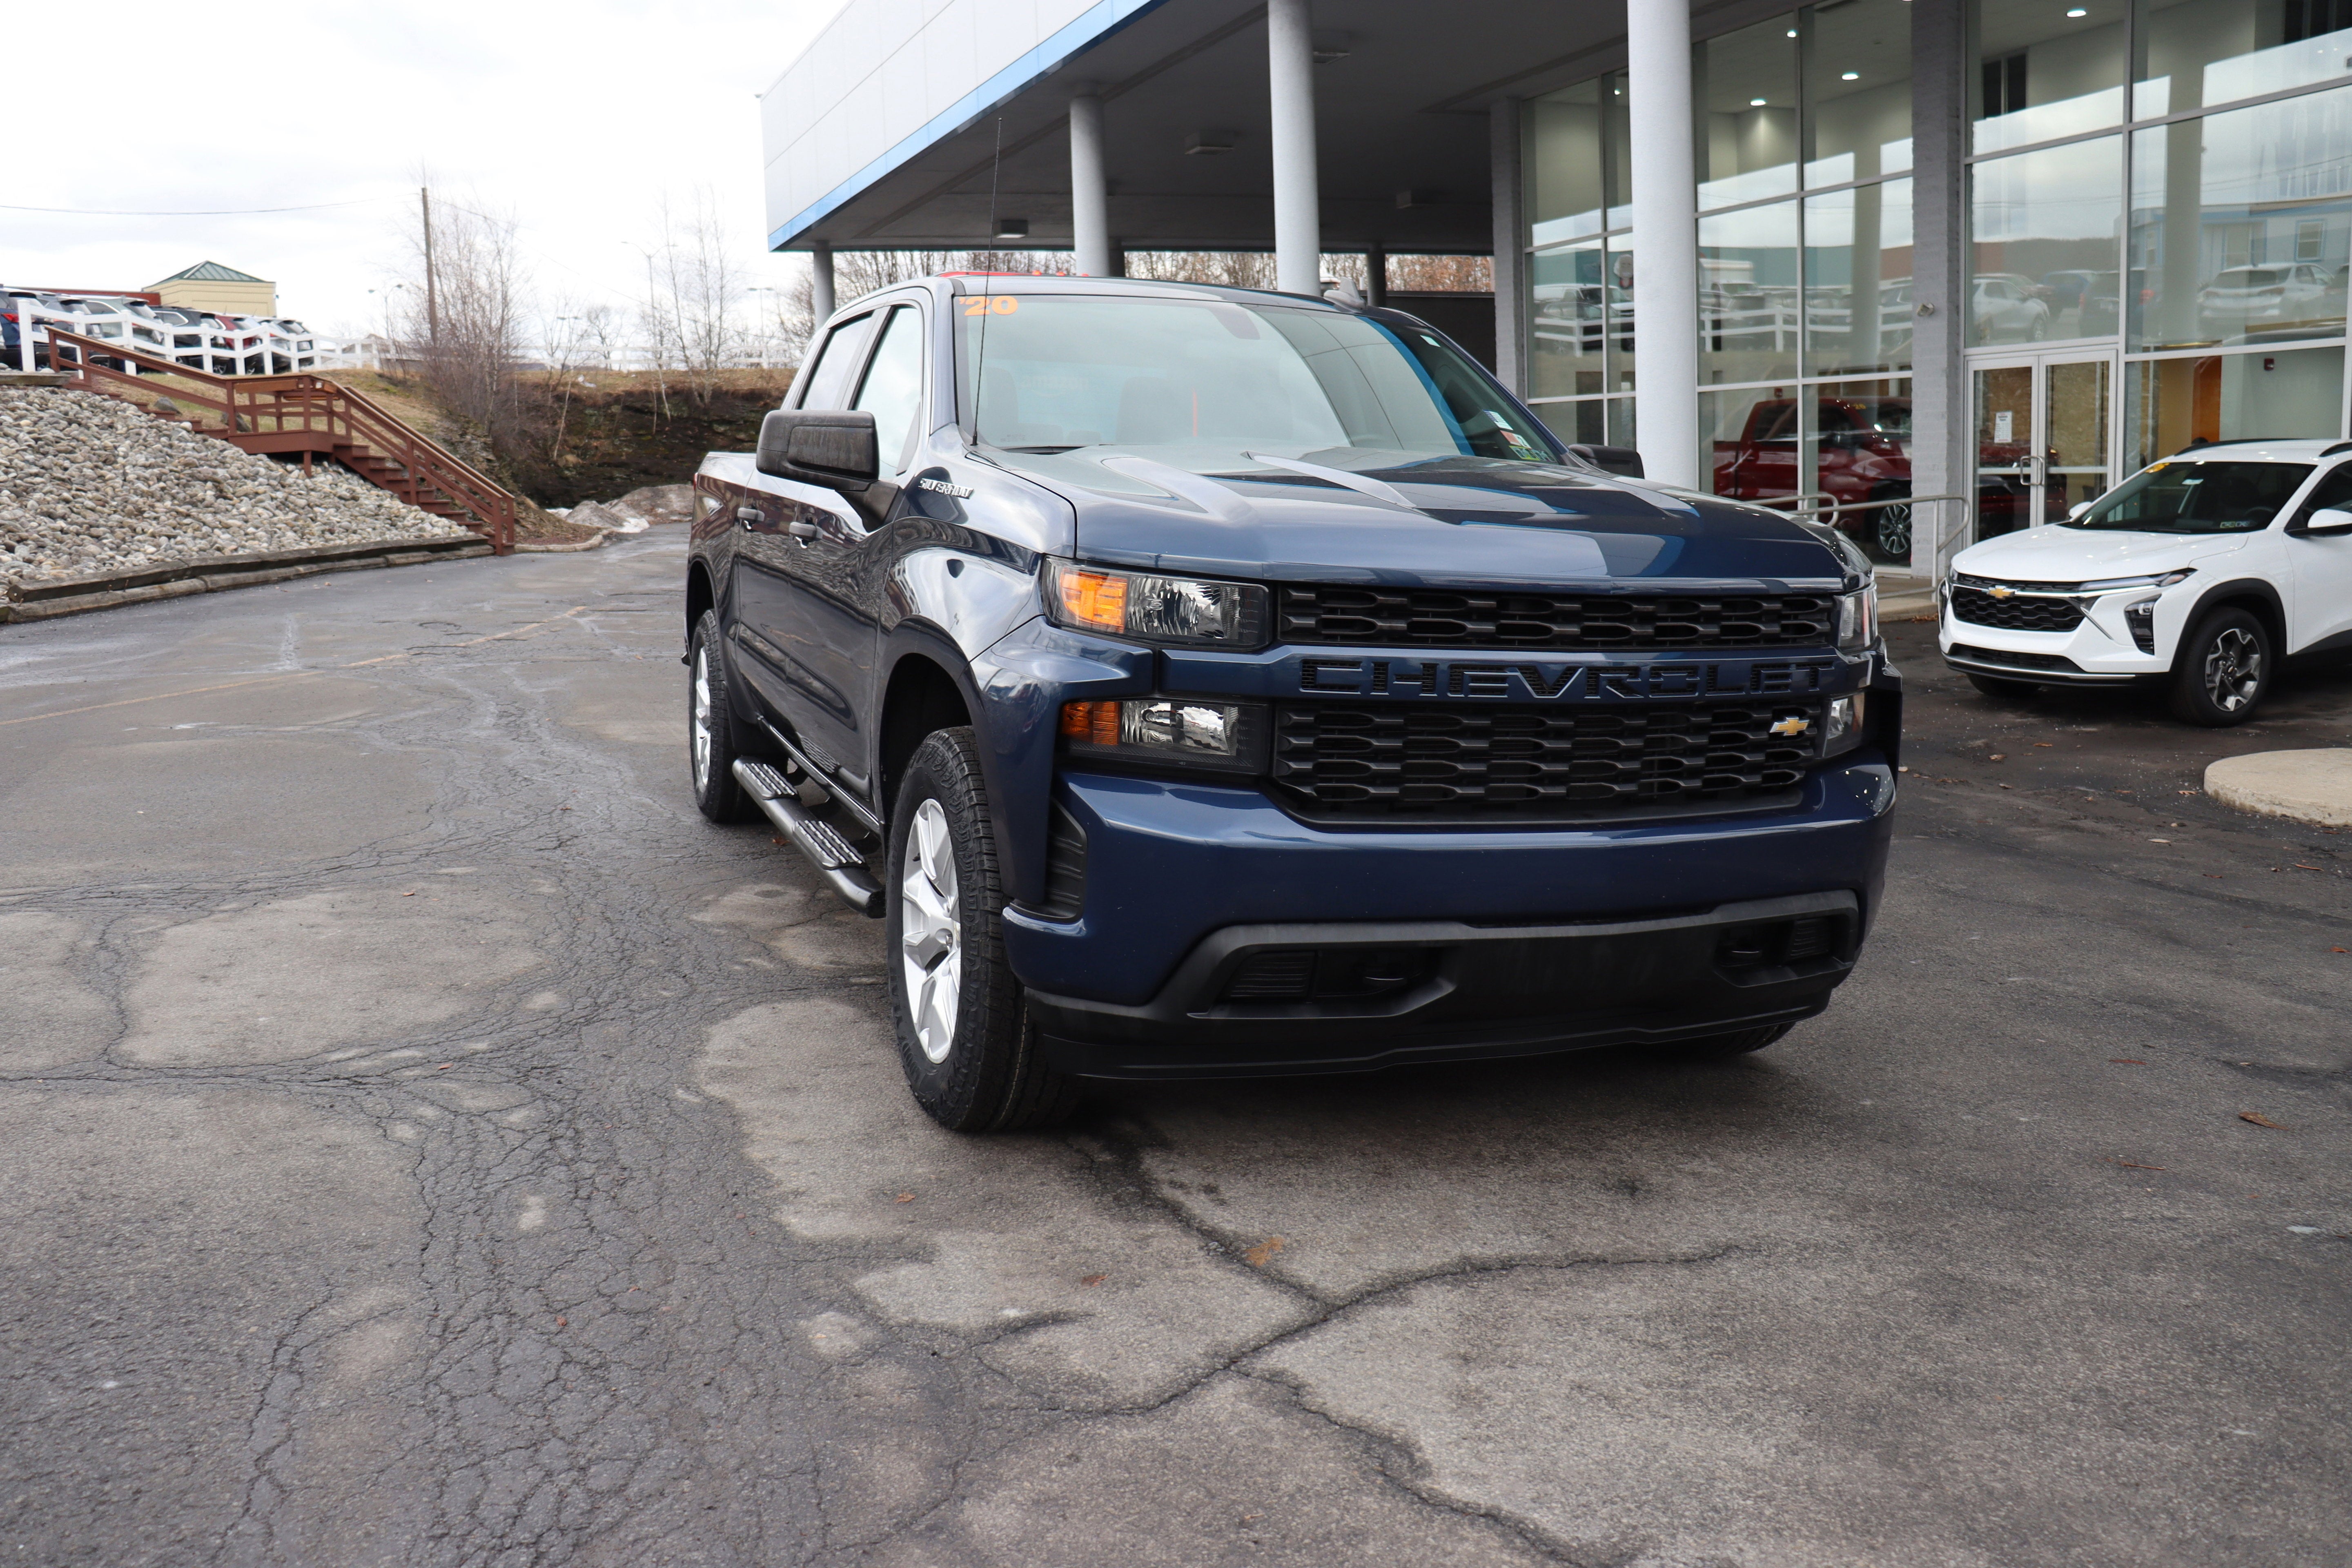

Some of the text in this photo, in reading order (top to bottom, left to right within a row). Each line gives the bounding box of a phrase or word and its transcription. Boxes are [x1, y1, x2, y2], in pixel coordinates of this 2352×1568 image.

[959, 296, 1018, 316] '20
[918, 478, 974, 499] SILVERADO
[1298, 658, 1836, 699] CHEVROLET
